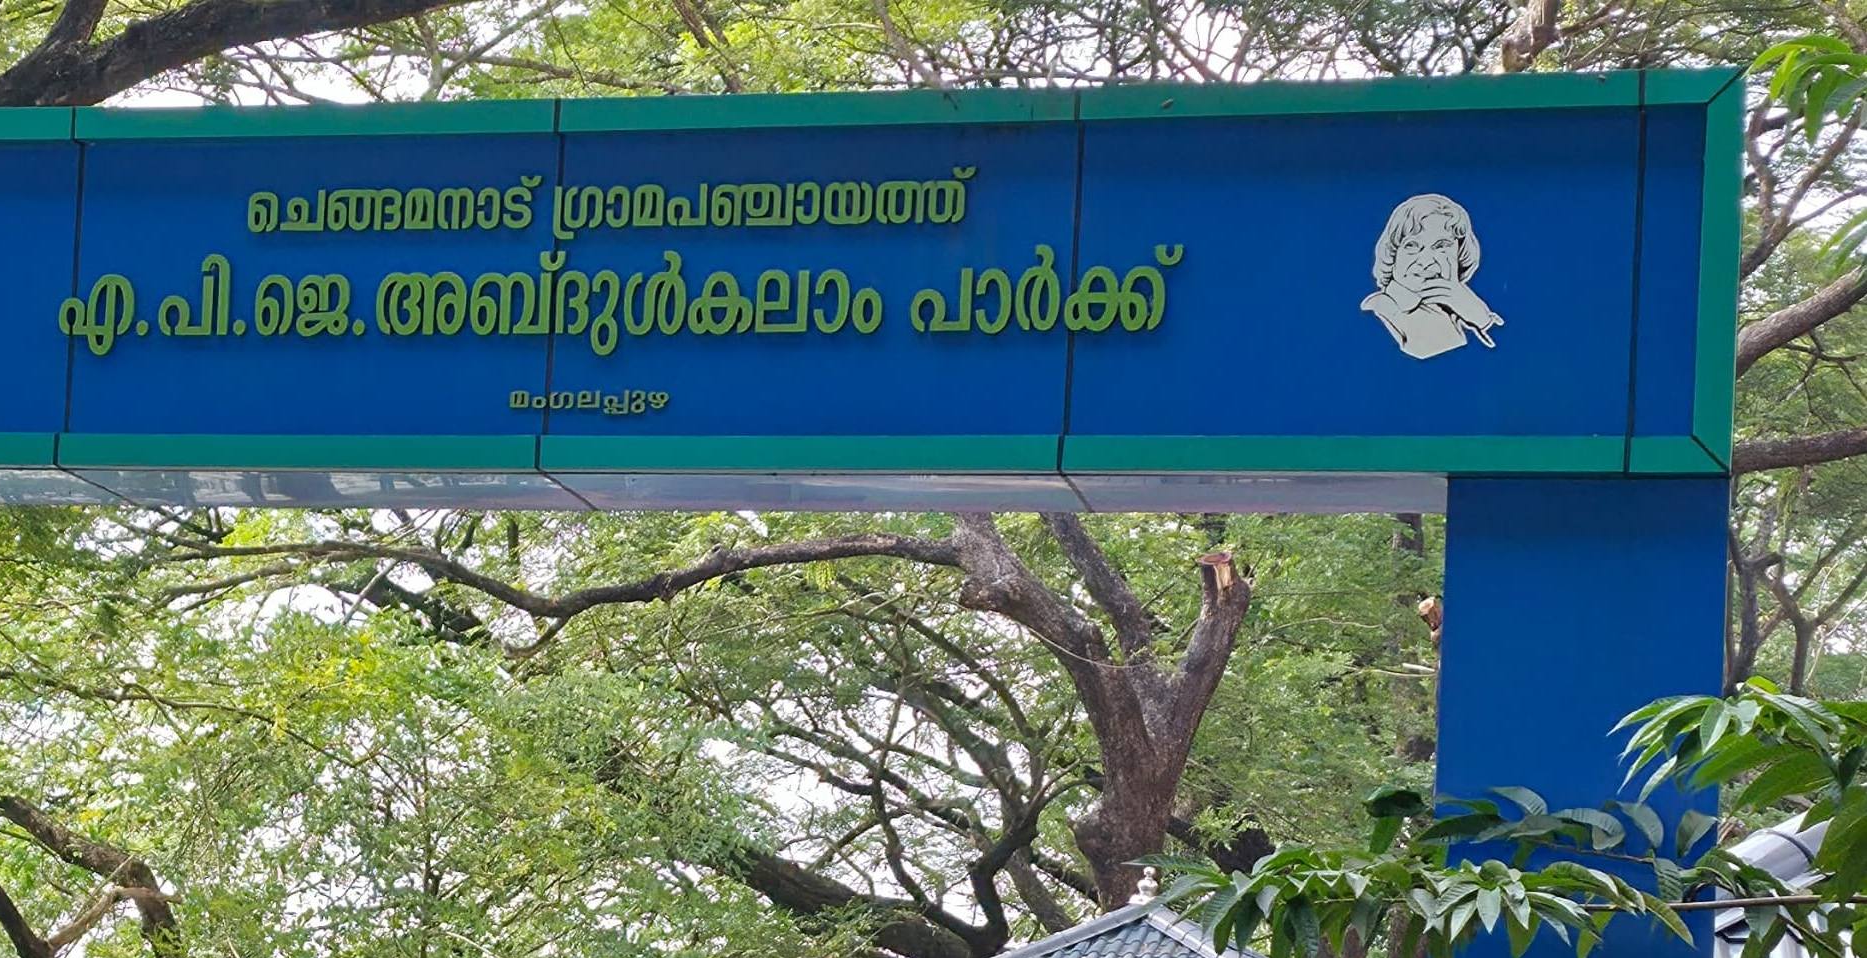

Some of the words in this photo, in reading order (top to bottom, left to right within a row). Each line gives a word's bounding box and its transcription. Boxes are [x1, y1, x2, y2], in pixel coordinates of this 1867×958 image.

[247, 175, 542, 233] ചെങ്ങമനാട്
[552, 166, 977, 240] ഗ്രാമപഞ്ചായത്ത്
[910, 244, 1184, 334] പാർക്ക്
[509, 389, 670, 415] മംഗലപ്പുഴ
